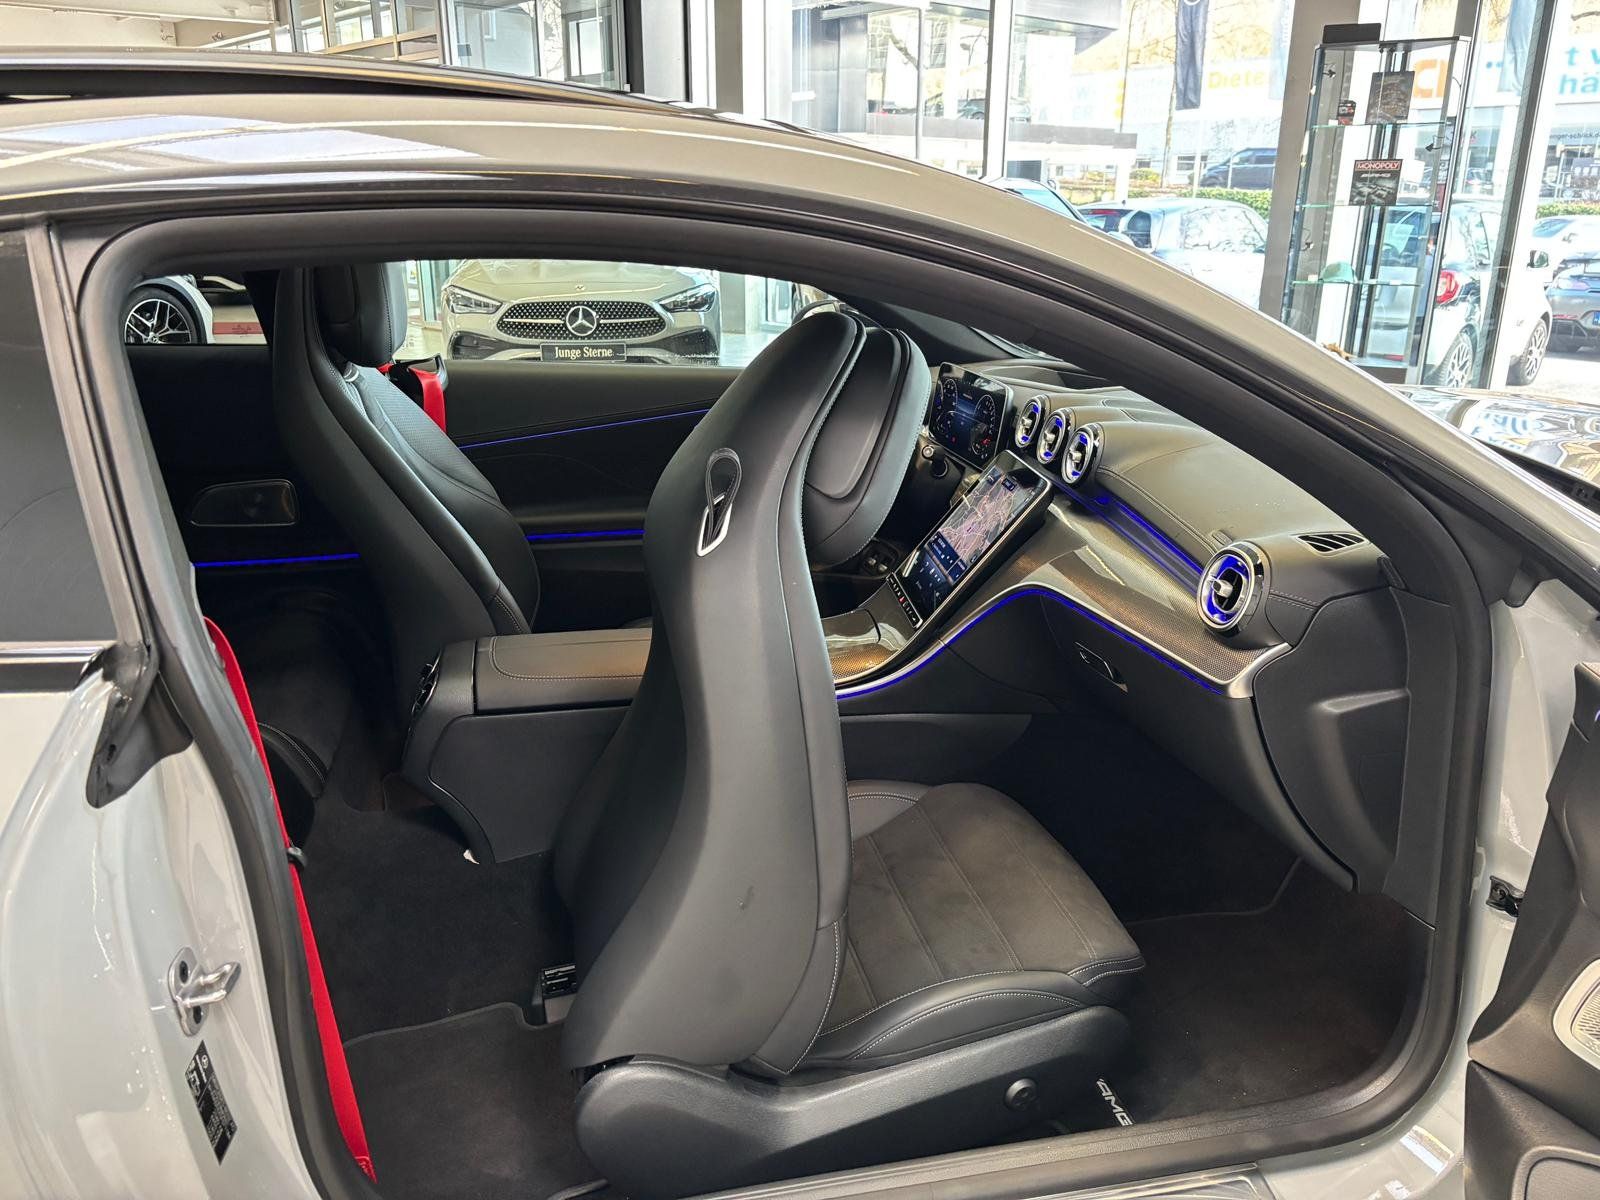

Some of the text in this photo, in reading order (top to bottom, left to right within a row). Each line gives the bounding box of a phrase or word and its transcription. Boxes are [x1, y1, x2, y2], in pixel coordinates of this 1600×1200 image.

[1356, 161, 1400, 169] MONOPOLY
[555, 346, 613, 360] Junge Sterne
[1096, 1078, 1133, 1126] AMG
